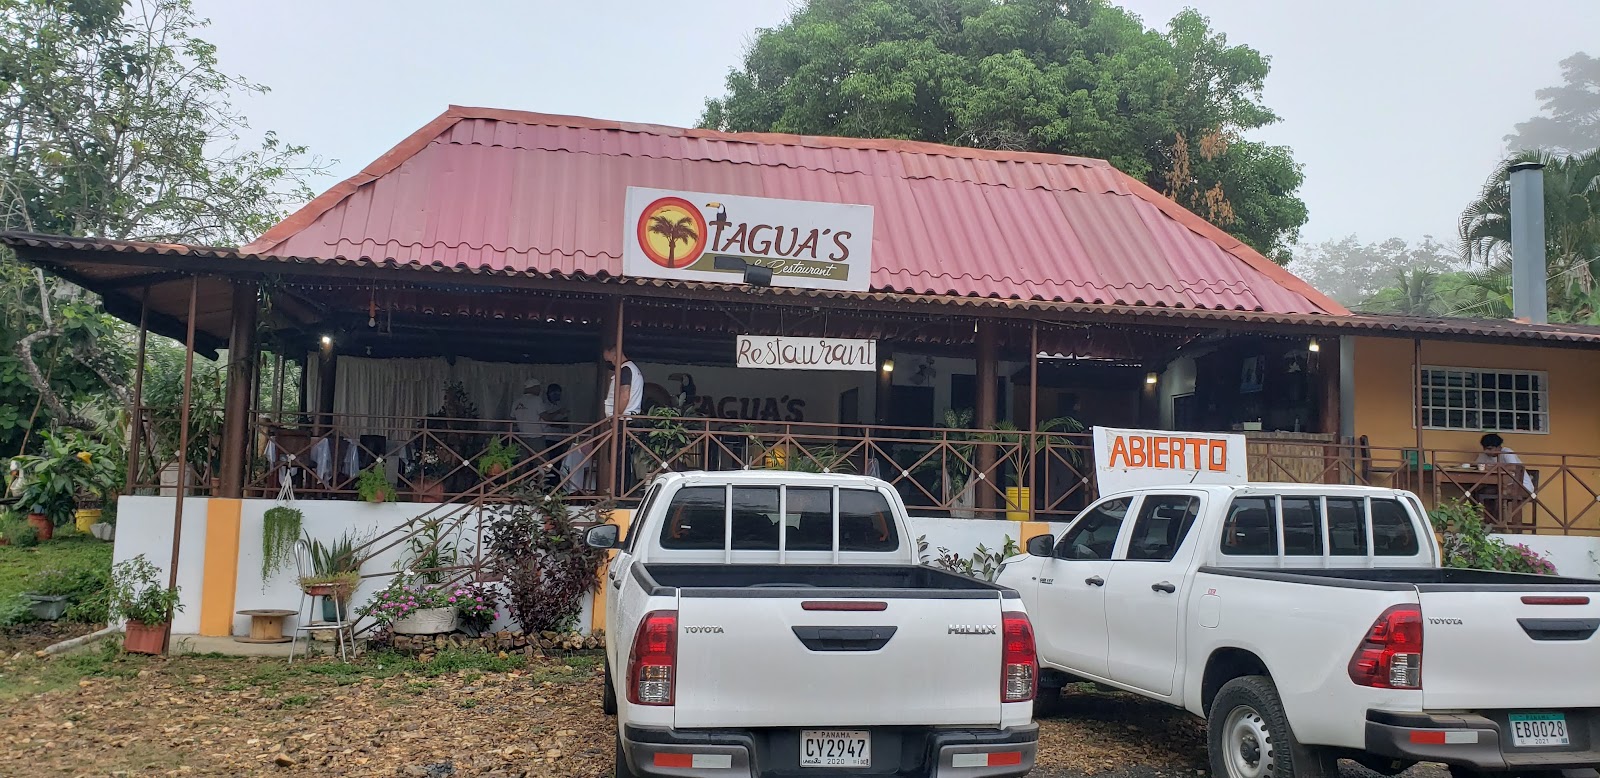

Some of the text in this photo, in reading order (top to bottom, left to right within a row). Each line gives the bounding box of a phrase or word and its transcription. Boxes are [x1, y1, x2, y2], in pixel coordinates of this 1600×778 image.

[708, 220, 852, 262] TAGUA'S
[767, 259, 837, 276] Restaurant
[737, 338, 875, 366] Restaurant
[690, 395, 806, 422] AGUA'S
[1109, 435, 1227, 471] ABIERTO
[684, 625, 724, 634] TOYOTA
[948, 624, 997, 635] HILUX
[1428, 617, 1463, 625] TOYOTA
[1515, 721, 1564, 738] EB0028
[806, 738, 865, 757] CY2947
